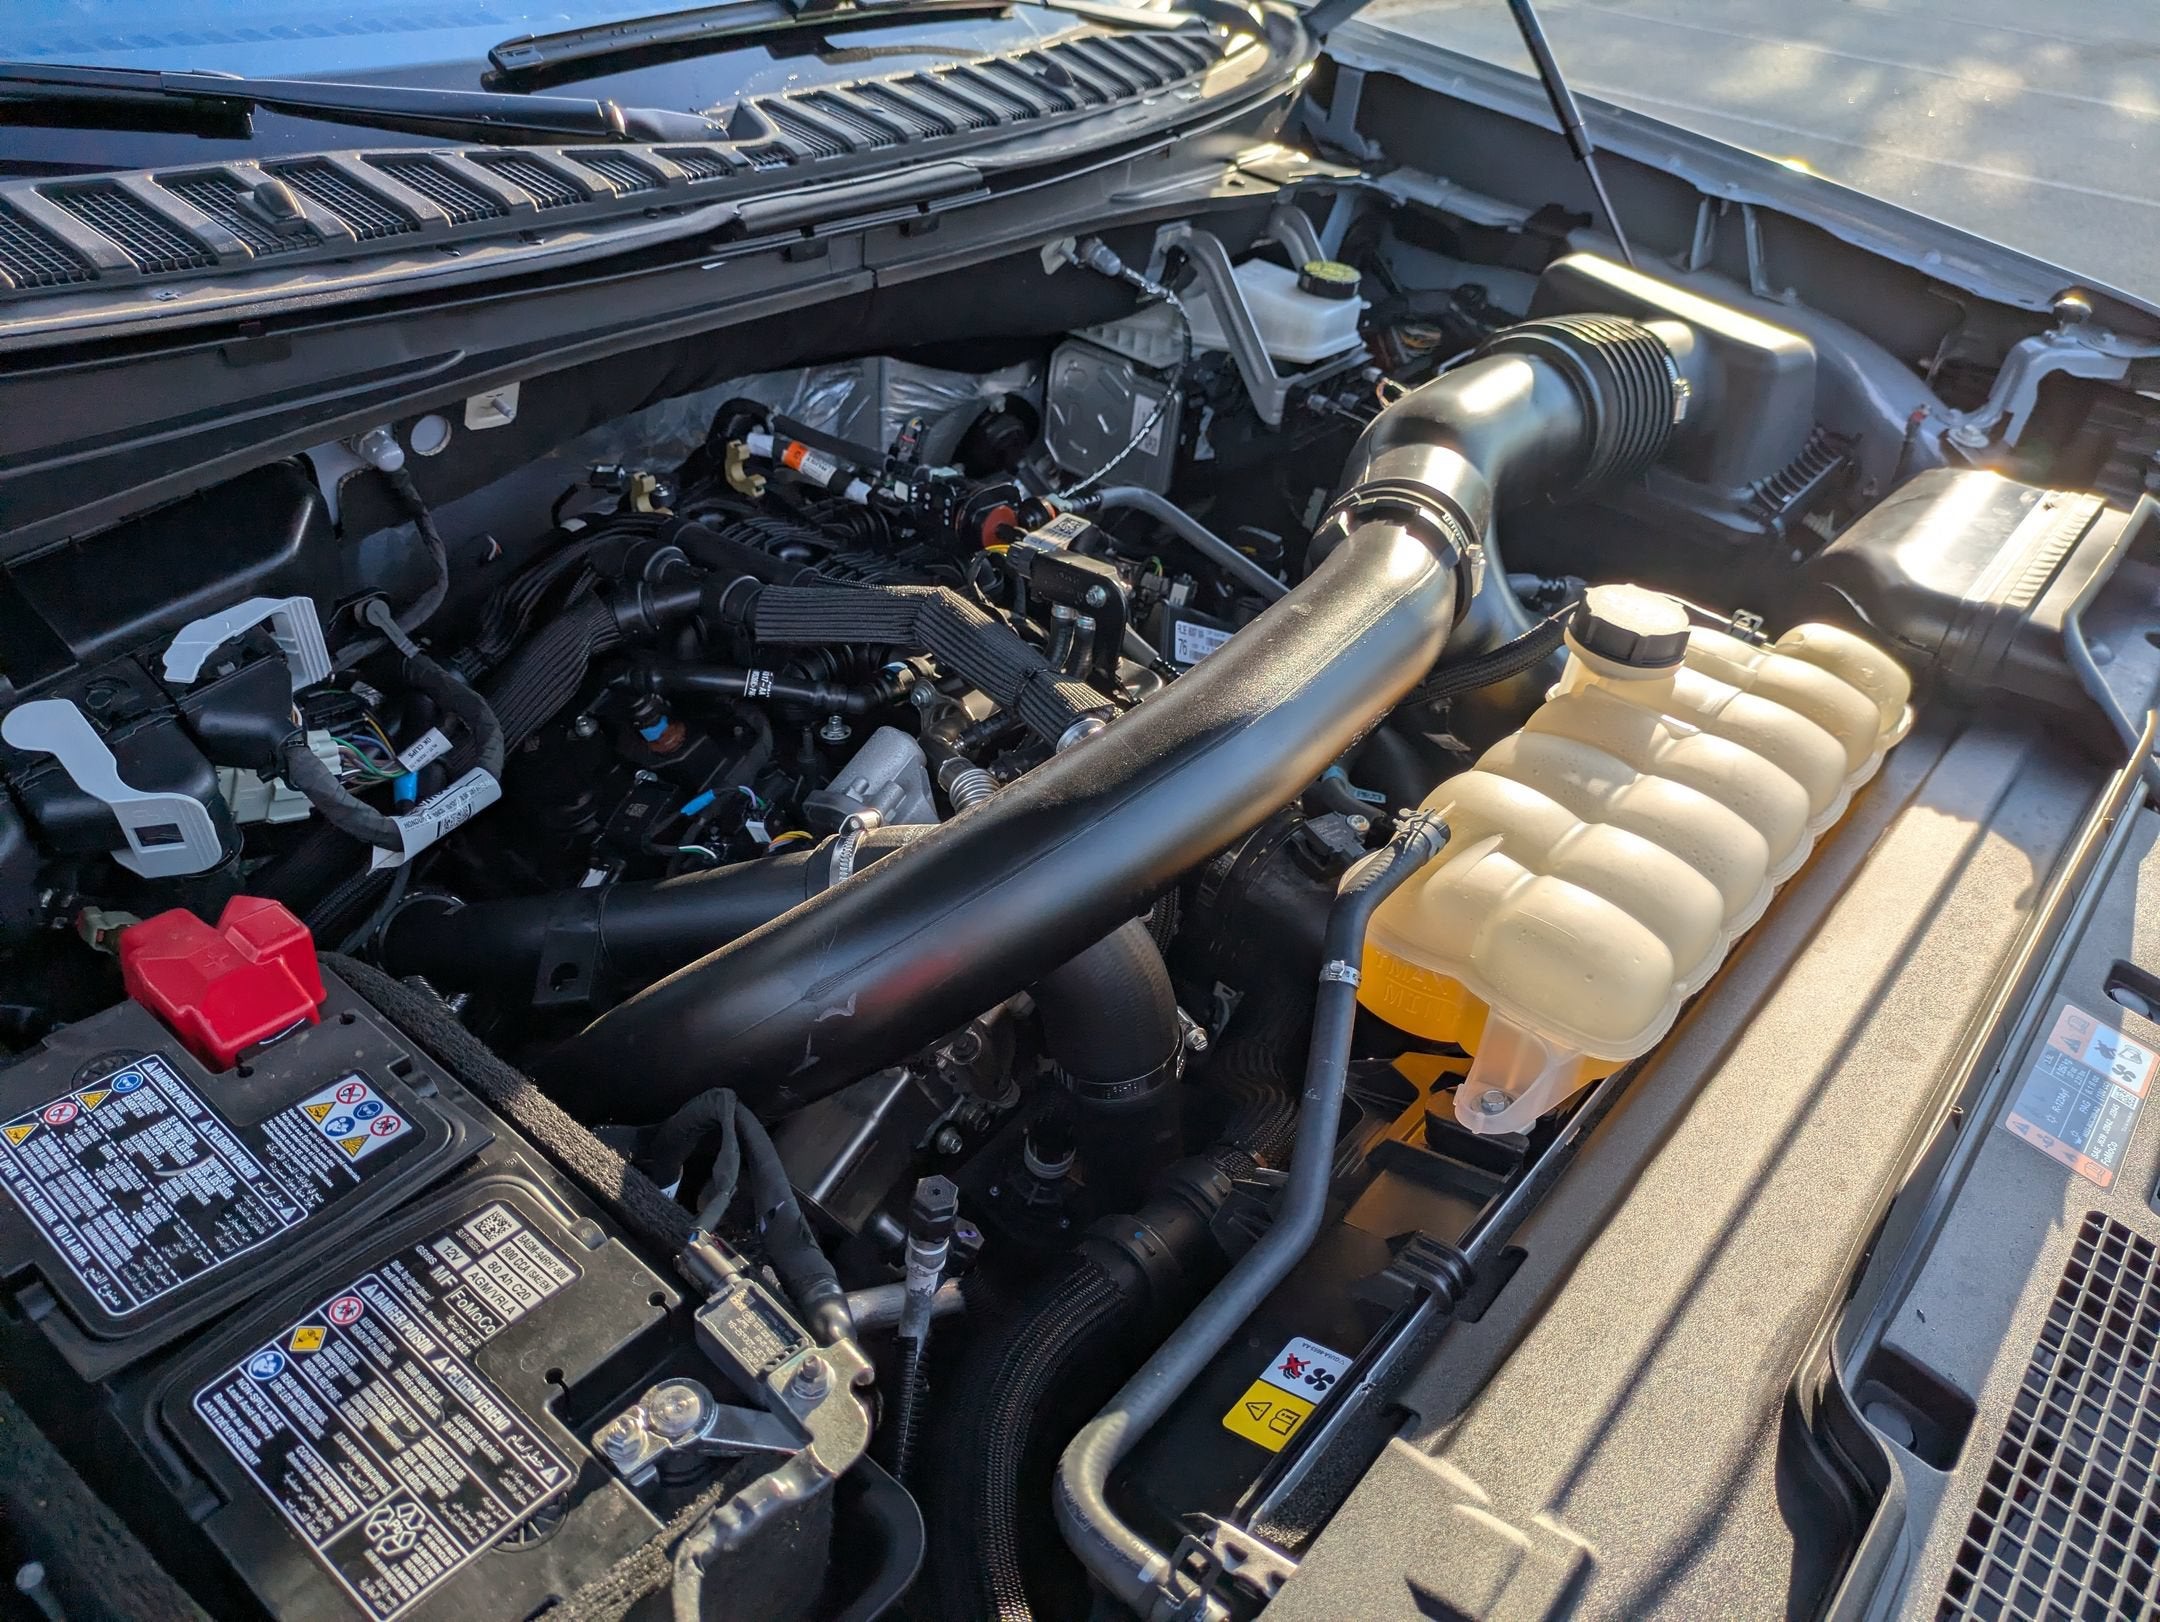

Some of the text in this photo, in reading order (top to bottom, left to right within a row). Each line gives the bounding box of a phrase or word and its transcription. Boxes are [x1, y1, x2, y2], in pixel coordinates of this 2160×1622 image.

[408, 743, 424, 759] CLIPS
[1383, 983, 1443, 1022] MIN
[148, 1067, 203, 1117] DANGER/POISON
[2051, 1087, 2071, 1114] R-1234yf
[2078, 1098, 2091, 1114] PAG
[299, 1121, 311, 1132] USA
[204, 1126, 261, 1180] PELIGRO/VENENO
[2090, 1145, 2101, 1159] SAE
[2100, 1139, 2118, 1167] FoMoCo
[13, 1178, 28, 1189] NE
[21, 1186, 39, 1201] PAS
[30, 1197, 60, 1226] OUVRIR.
[52, 1223, 69, 1237] NO
[60, 1233, 77, 1247] LA
[67, 1242, 93, 1267] ABRA.
[440, 1244, 463, 1262] 12V
[514, 1234, 571, 1280] BAGM-94RH7-800
[428, 1264, 460, 1290] MF
[486, 1260, 532, 1301] 80 Ah C20
[500, 1245, 553, 1292] 800 CCA (SAE/EN)
[466, 1270, 518, 1315] AGM/VRLA
[370, 1290, 436, 1354] DANGER/POISON
[449, 1289, 499, 1335] FoMoCo
[268, 1378, 285, 1394] LIRE
[278, 1389, 293, 1403] LES
[278, 1371, 297, 1389] READ
[234, 1376, 285, 1431] NON-SPILLABLE
[441, 1363, 511, 1431] PELIGRO/VENENO
[211, 1391, 263, 1448] Batterie au plomb
[224, 1383, 276, 1441] Lead Acid Battery
[200, 1399, 263, 1467] ANTI DÉVERSEMENT
[294, 1444, 359, 1514] CONTRA DERRAMES
[387, 1518, 406, 1535] Pb
